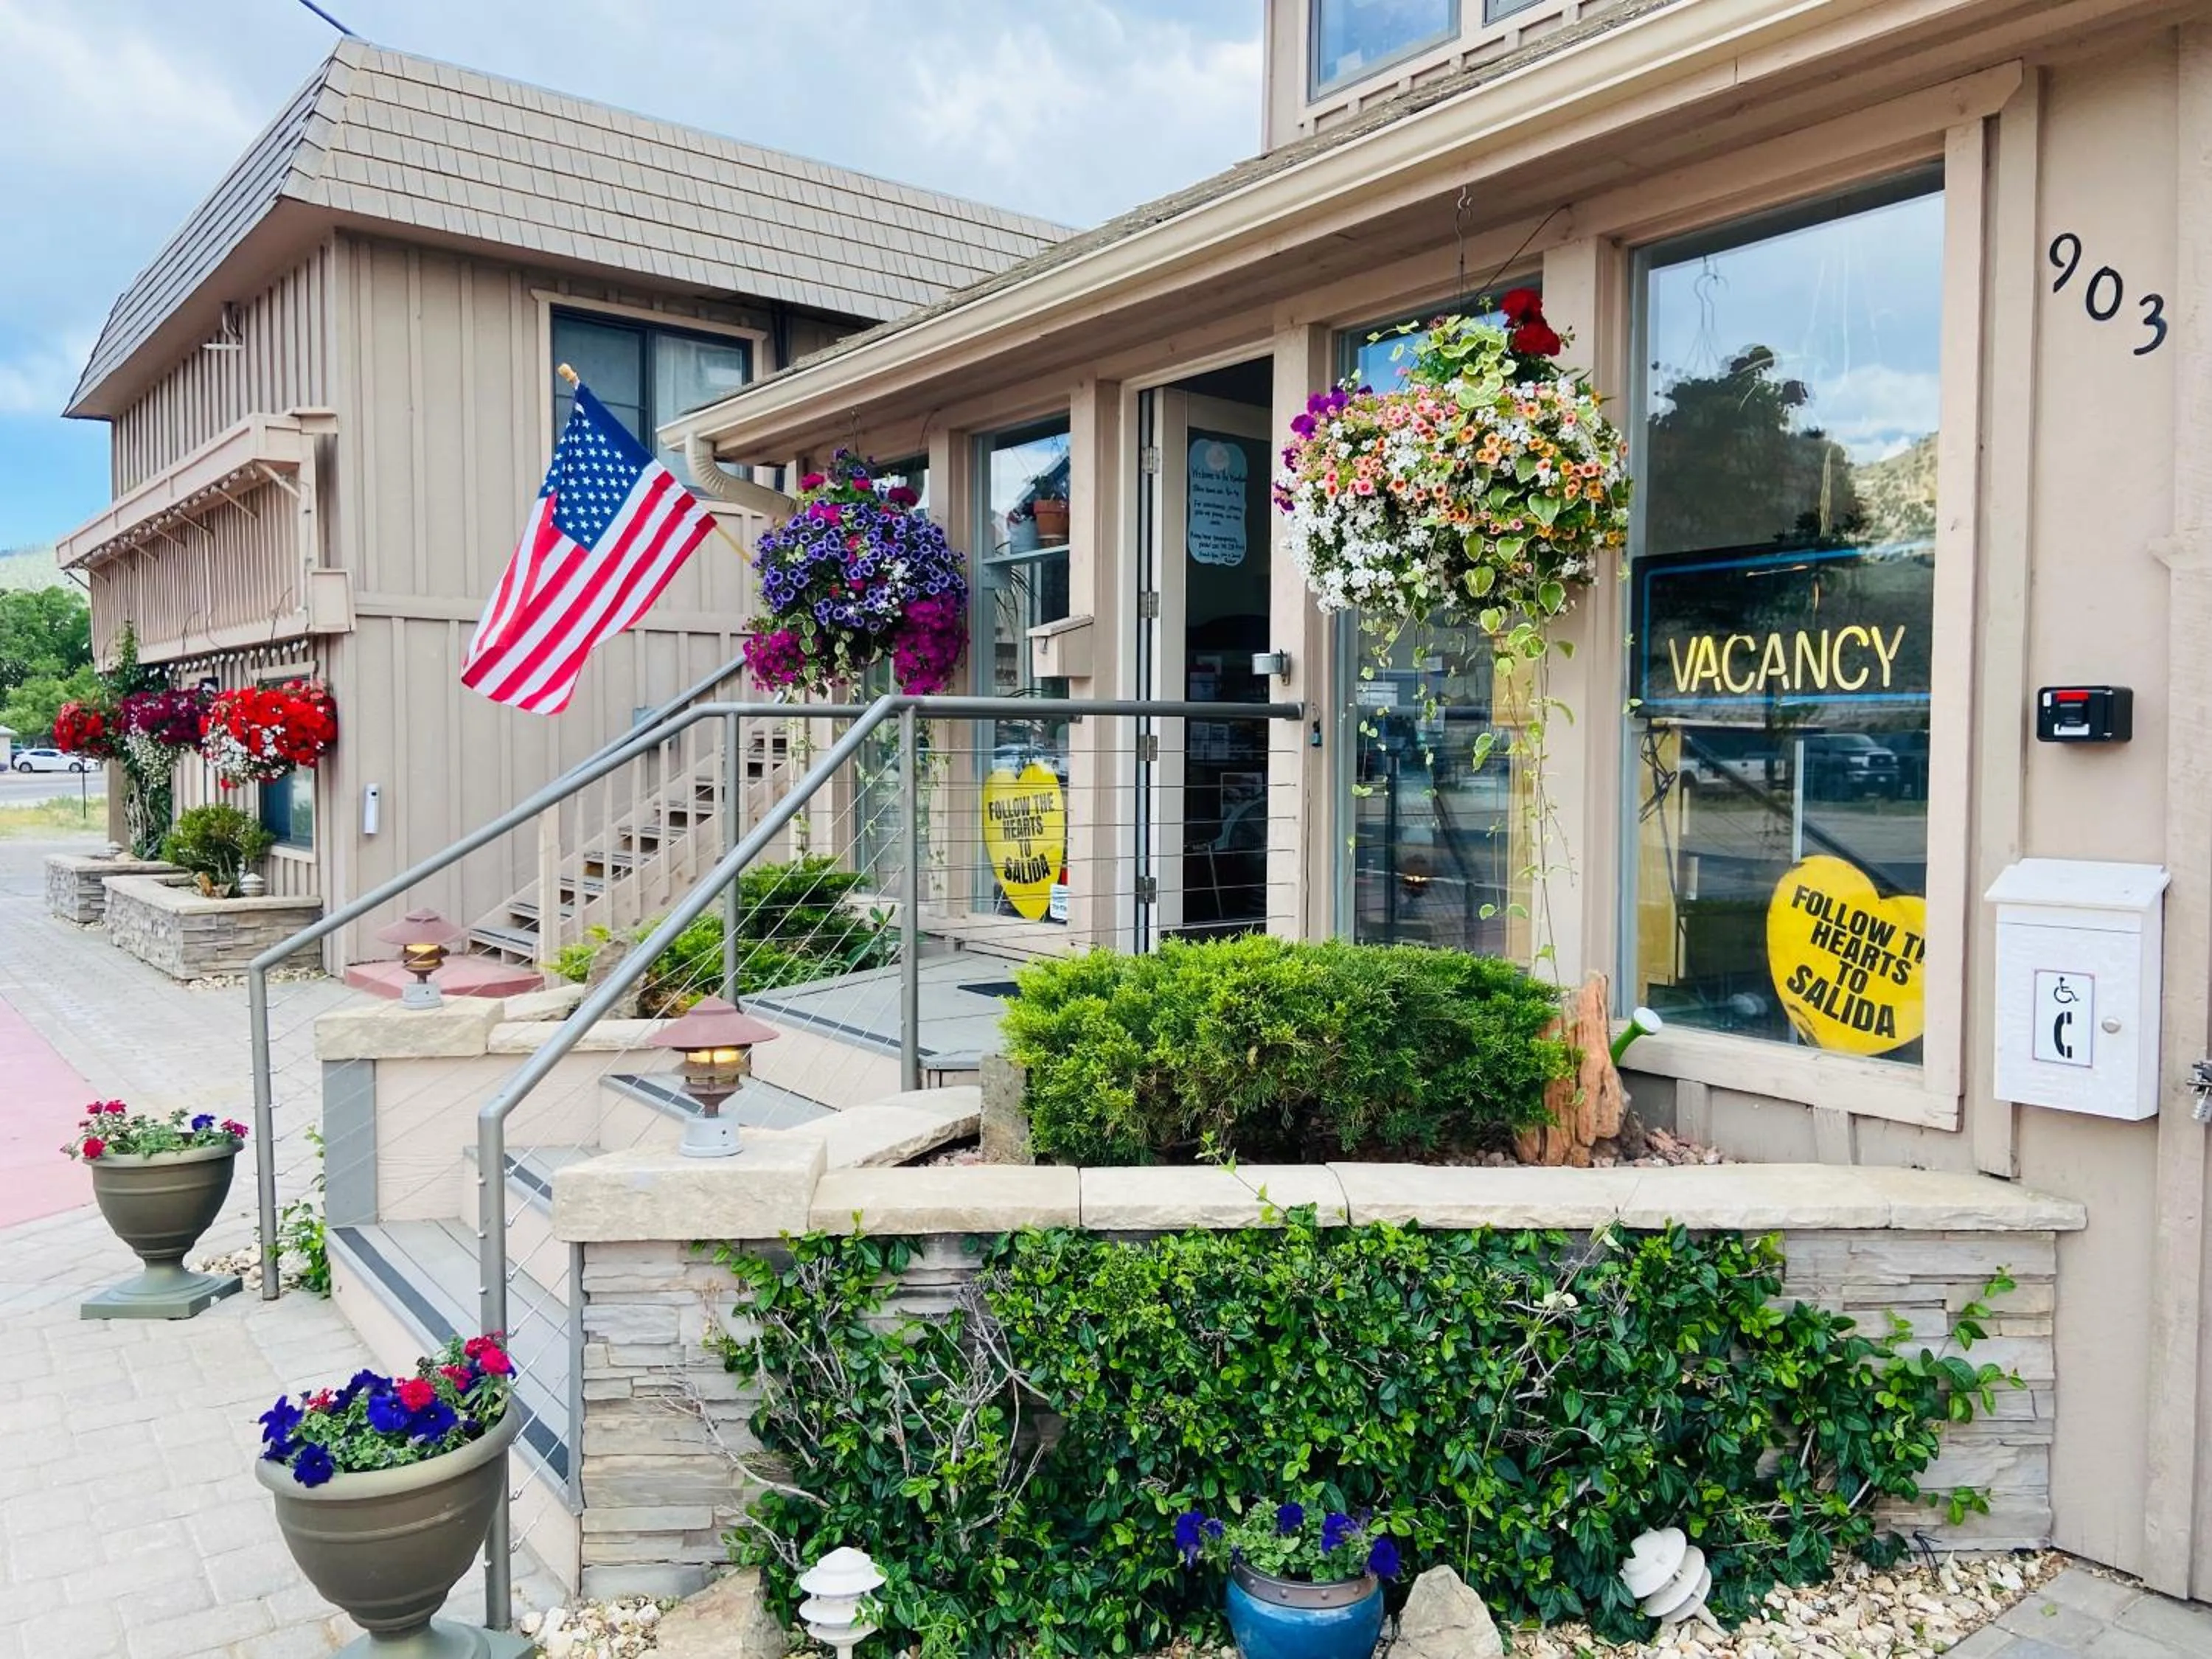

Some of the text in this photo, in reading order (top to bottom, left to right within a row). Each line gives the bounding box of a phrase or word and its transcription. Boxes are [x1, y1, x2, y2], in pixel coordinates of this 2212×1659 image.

[2049, 232, 2168, 355] 903
[1669, 625, 1905, 694] VACANCY
[988, 792, 1054, 821] FOLLOW THE
[1003, 815, 1043, 841] HEARTS
[1004, 854, 1051, 884] SALIDA
[1018, 839, 1032, 858] TO
[1791, 885, 1896, 947] FOLLOW
[1811, 920, 1912, 985] HEARTS
[1787, 964, 1896, 1039] SALIDA
[1836, 960, 1869, 995] TO
